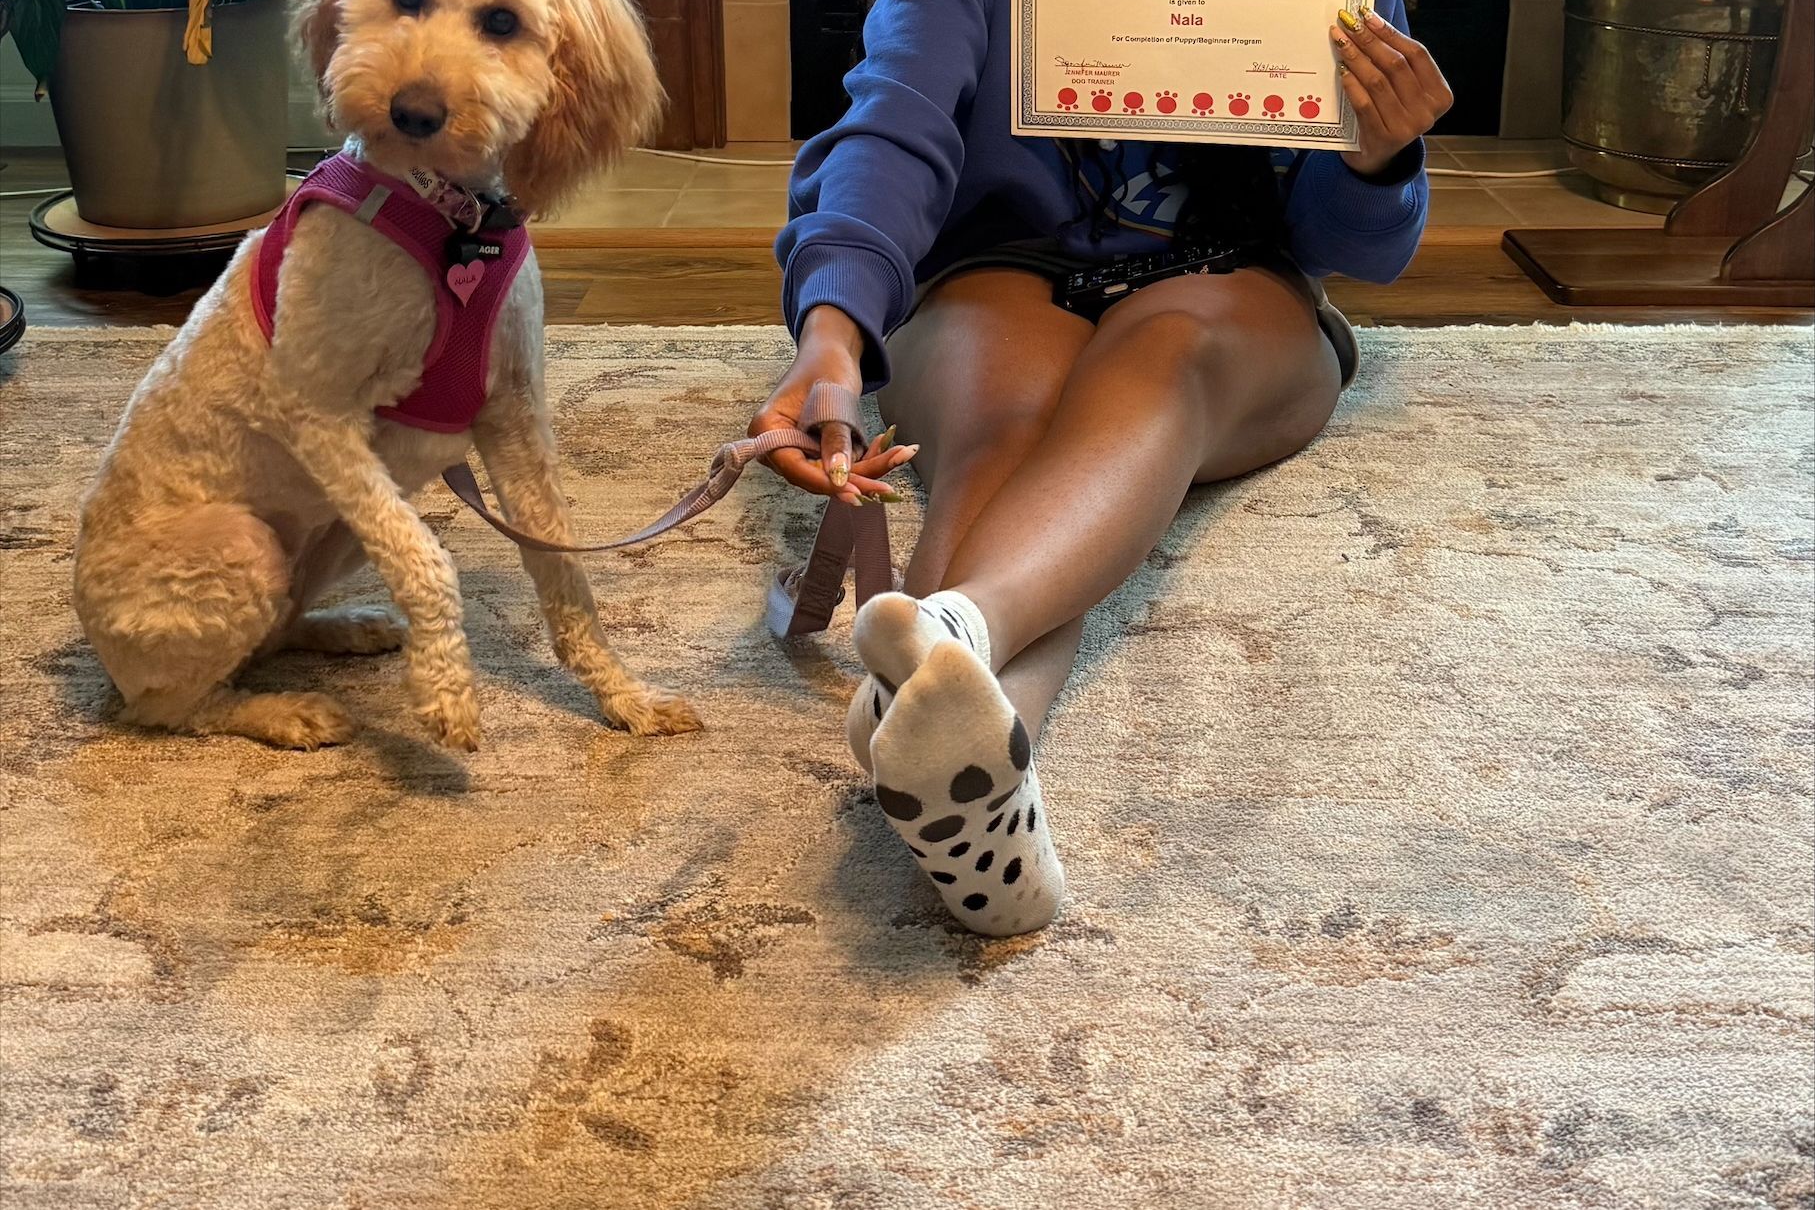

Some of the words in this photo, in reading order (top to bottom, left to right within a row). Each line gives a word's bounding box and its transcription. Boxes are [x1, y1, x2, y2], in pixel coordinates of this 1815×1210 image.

[1170, 13, 1204, 26] Nala
[1111, 34, 1124, 43] For
[1125, 34, 1165, 44] Completion
[1166, 35, 1173, 43] of
[1231, 37, 1262, 46] Program
